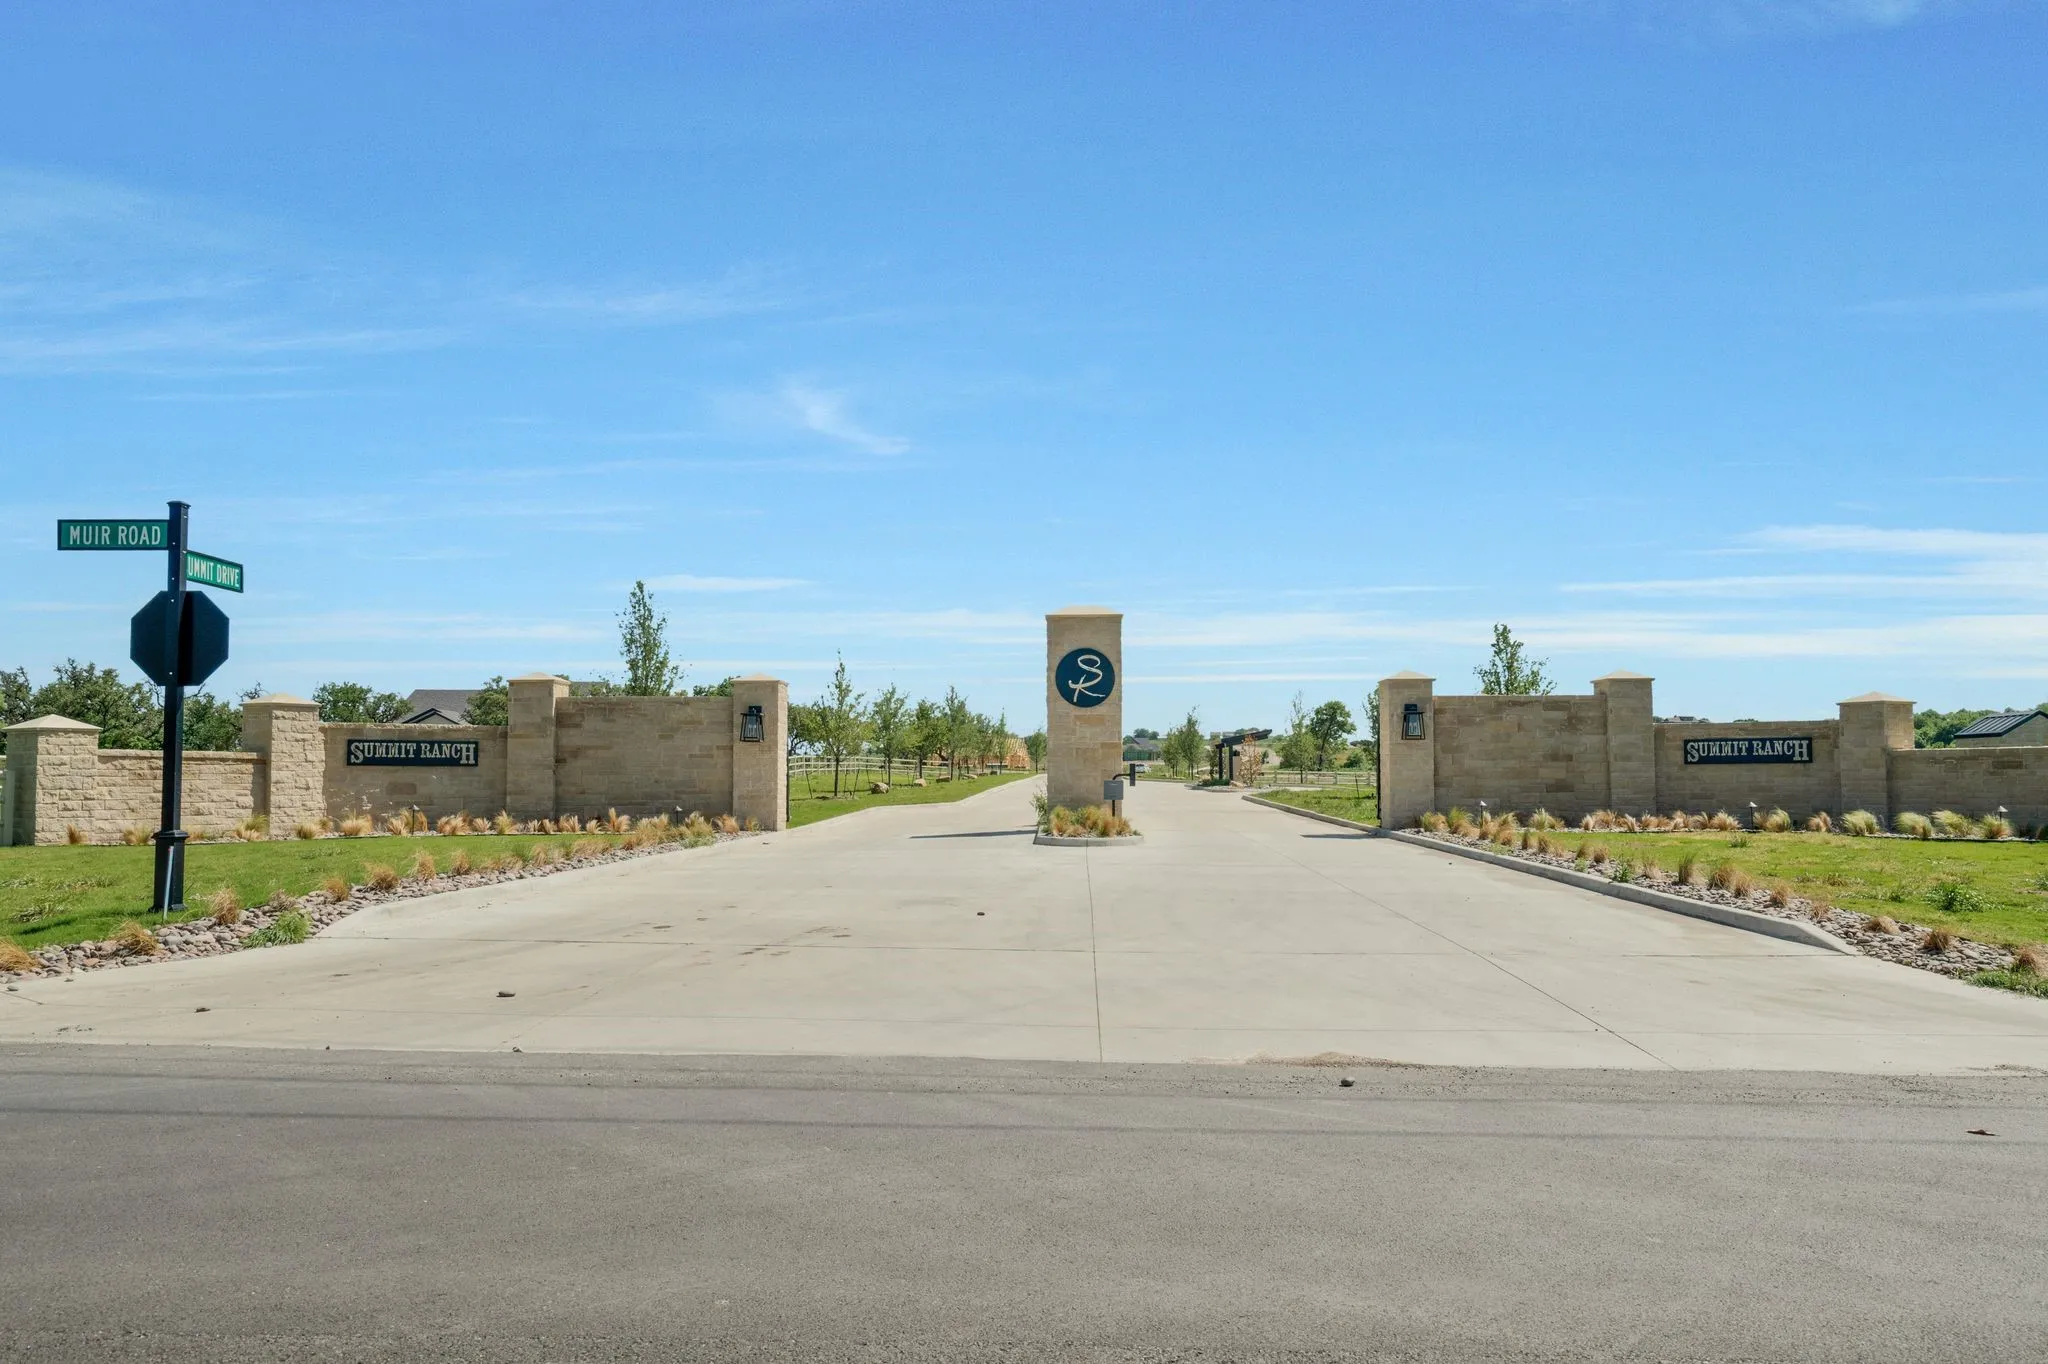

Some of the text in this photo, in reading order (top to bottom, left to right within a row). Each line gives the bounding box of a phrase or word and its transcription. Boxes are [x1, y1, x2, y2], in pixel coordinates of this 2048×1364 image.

[69, 525, 161, 545] MUIR ROAD
[187, 556, 240, 588] UMMIT DRIVE
[350, 742, 476, 764] SUMMIT RANCH
[1686, 740, 1810, 762] SUMMIT RANCH
